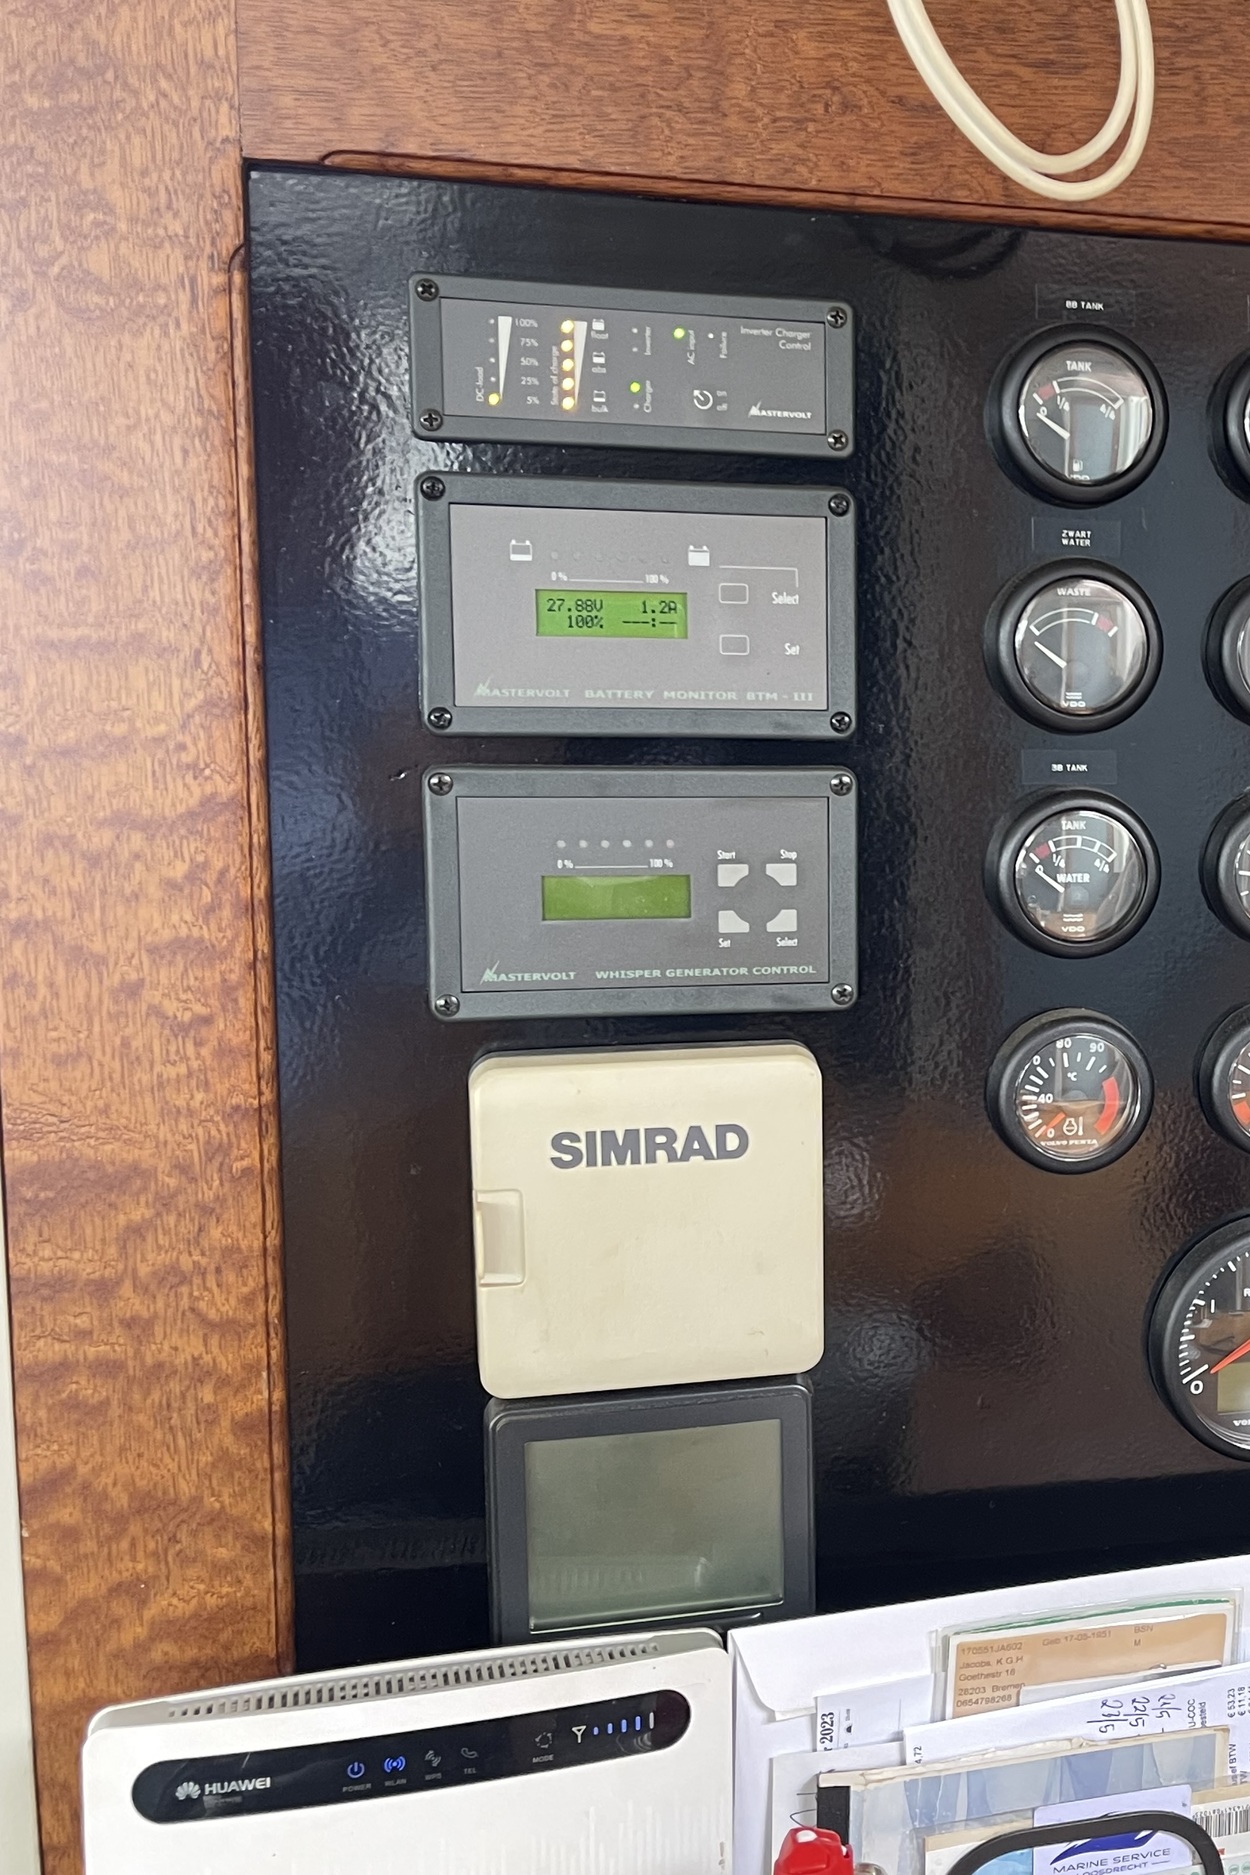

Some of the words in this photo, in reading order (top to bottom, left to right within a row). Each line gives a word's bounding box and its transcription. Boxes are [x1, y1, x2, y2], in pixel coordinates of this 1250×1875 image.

[1080, 301, 1104, 311] TANK
[515, 318, 538, 328] 100%
[740, 325, 773, 338] Inverter
[775, 327, 811, 340] Charger
[520, 338, 539, 347] 75%
[778, 340, 812, 351] Control
[520, 357, 539, 367] 50%
[1066, 360, 1092, 372] TANK
[520, 376, 540, 386] 25%
[526, 396, 540, 405] 5%
[1061, 530, 1092, 539] ZWART
[1061, 538, 1091, 547] WATER
[1057, 588, 1092, 597] WASTE
[771, 591, 799, 606] Select
[546, 598, 604, 613] 27.88V
[641, 600, 678, 615] 1.2A
[566, 615, 604, 630] 100%
[784, 642, 800, 656] Set
[585, 689, 655, 700] BATTERY
[664, 690, 738, 701] MONITOR
[746, 690, 778, 701] BTM
[1066, 764, 1088, 772] TANK
[1061, 820, 1087, 831] TANK
[717, 849, 736, 861] Start
[780, 848, 798, 862] Stop
[1052, 853, 1066, 869] 1/4
[1094, 858, 1110, 874] 4/4
[1056, 873, 1090, 883] WATER
[718, 938, 731, 948] Set
[776, 937, 798, 948] Select
[595, 969, 662, 980] WHISPER
[666, 967, 749, 979] GENERATOR
[753, 964, 817, 976] CONTROL
[1055, 1038, 1072, 1049] 80
[1089, 1042, 1105, 1053] 90
[1037, 1093, 1053, 1104] 40
[550, 1123, 749, 1170] SIMRAD
[1210, 1299, 1215, 1313] 1
[1190, 1380, 1204, 1394] 0
[820, 1712, 835, 1744] 2023
[1228, 1743, 1237, 1762] BTW
[532, 1754, 554, 1763] MODE
[463, 1767, 477, 1775] TEL
[204, 1777, 271, 1795] HUAWEI
[342, 1783, 372, 1793] POWER
[384, 1778, 407, 1787] WLAN
[1053, 1858, 1108, 1874] MARINE
[1112, 1848, 1171, 1864] SERVICE
